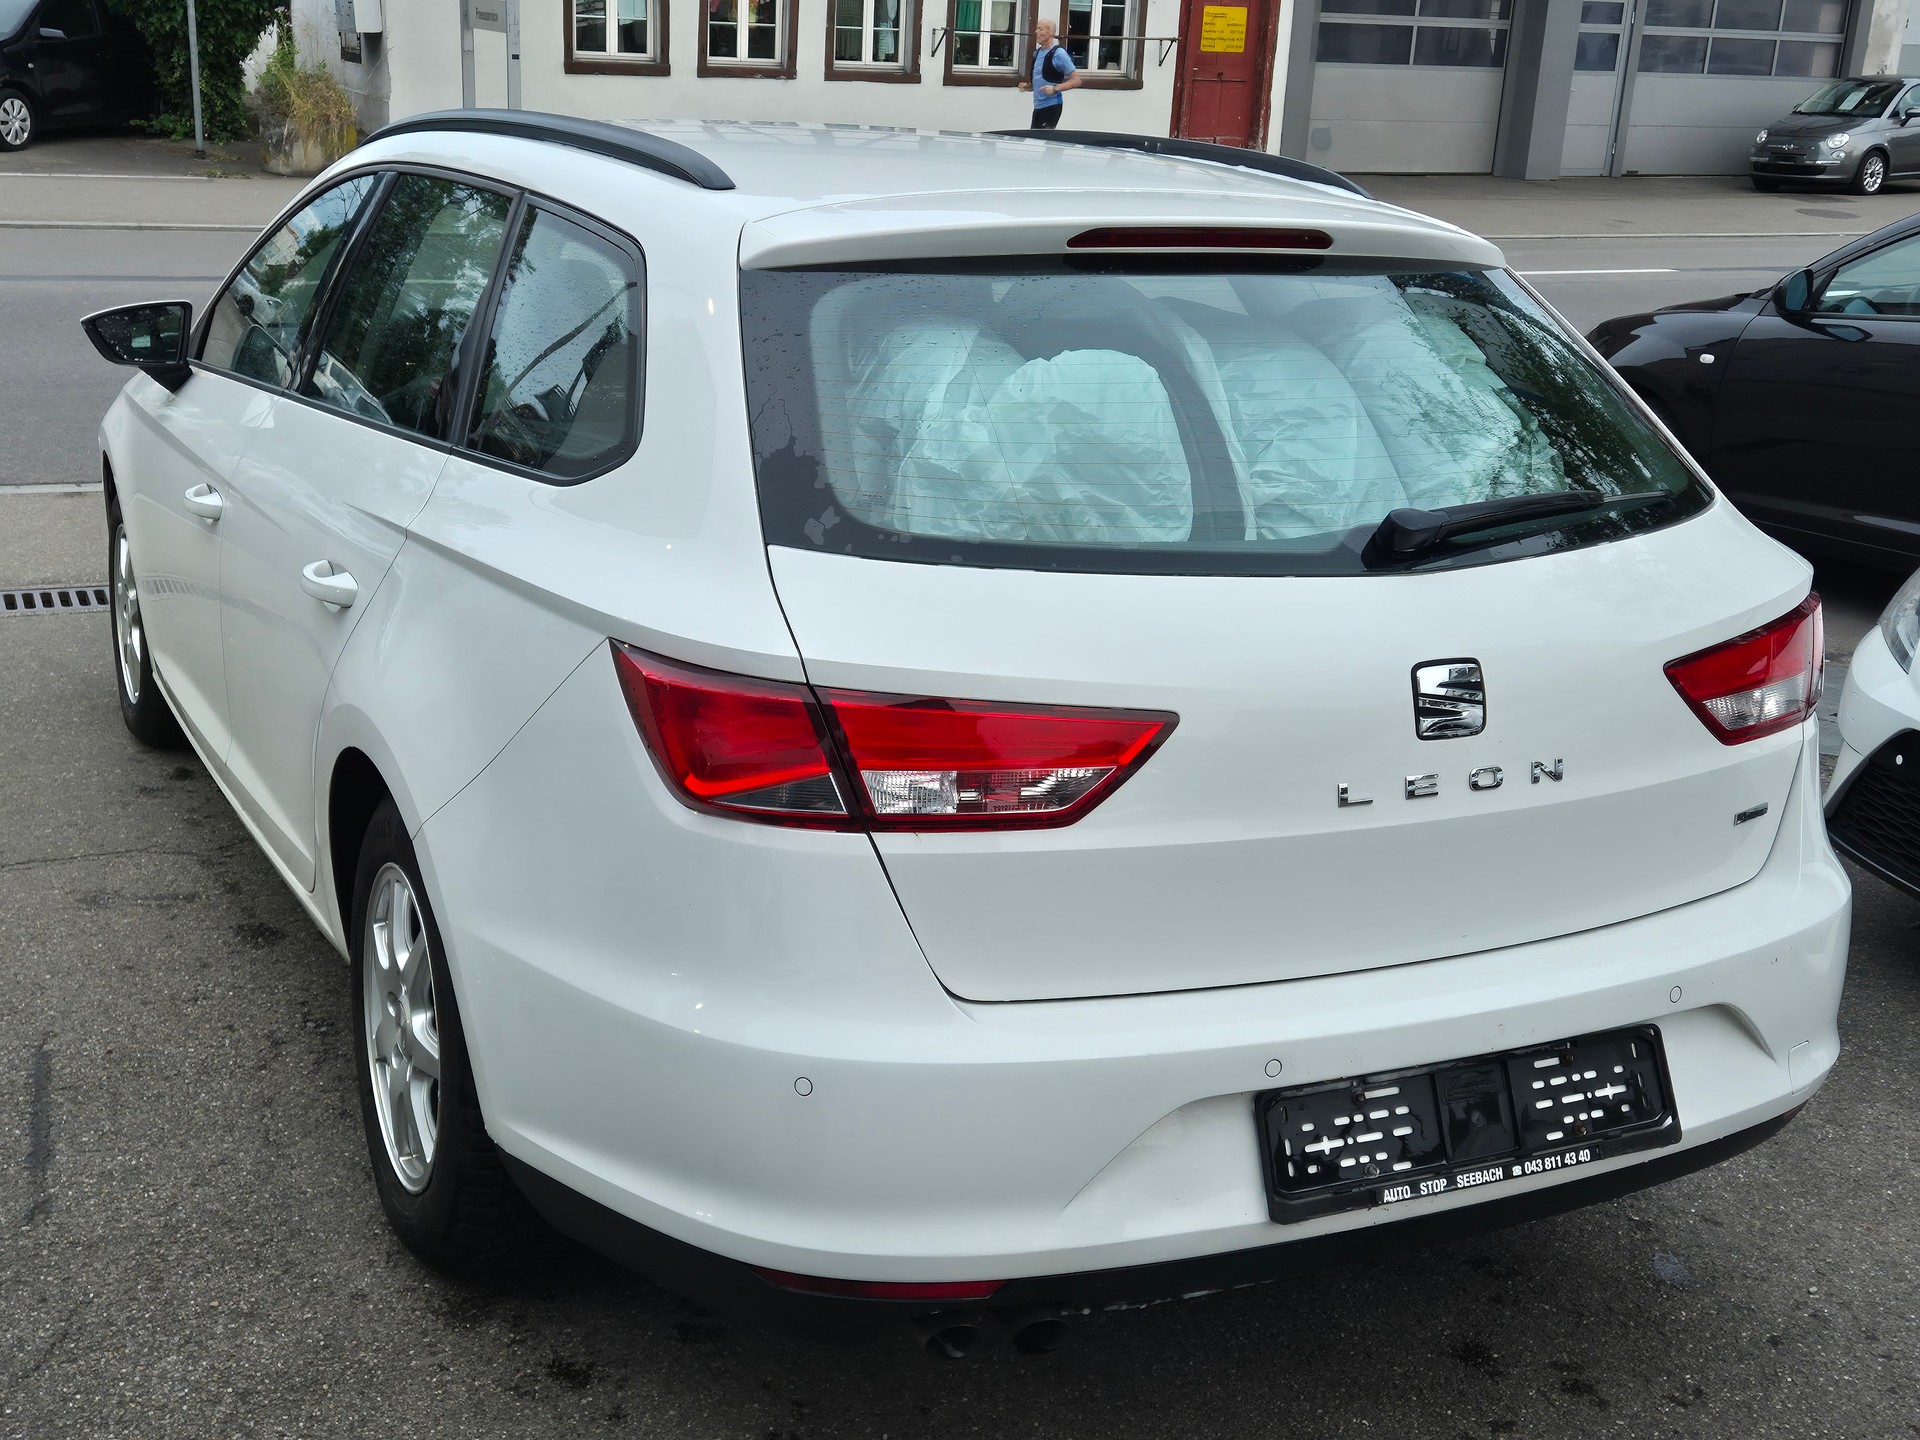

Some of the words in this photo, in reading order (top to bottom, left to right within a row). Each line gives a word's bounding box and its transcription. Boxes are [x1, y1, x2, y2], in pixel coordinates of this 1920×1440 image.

[1338, 759, 1564, 808] LEON
[1384, 1186, 1410, 1203] AUTO
[1420, 1178, 1447, 1195] STOP
[1457, 1167, 1503, 1188] SEEBACH
[1525, 1161, 1543, 1174] 043
[1545, 1156, 1561, 1170] 811
[1564, 1153, 1577, 1165] 43
[1578, 1149, 1591, 1162] 40
